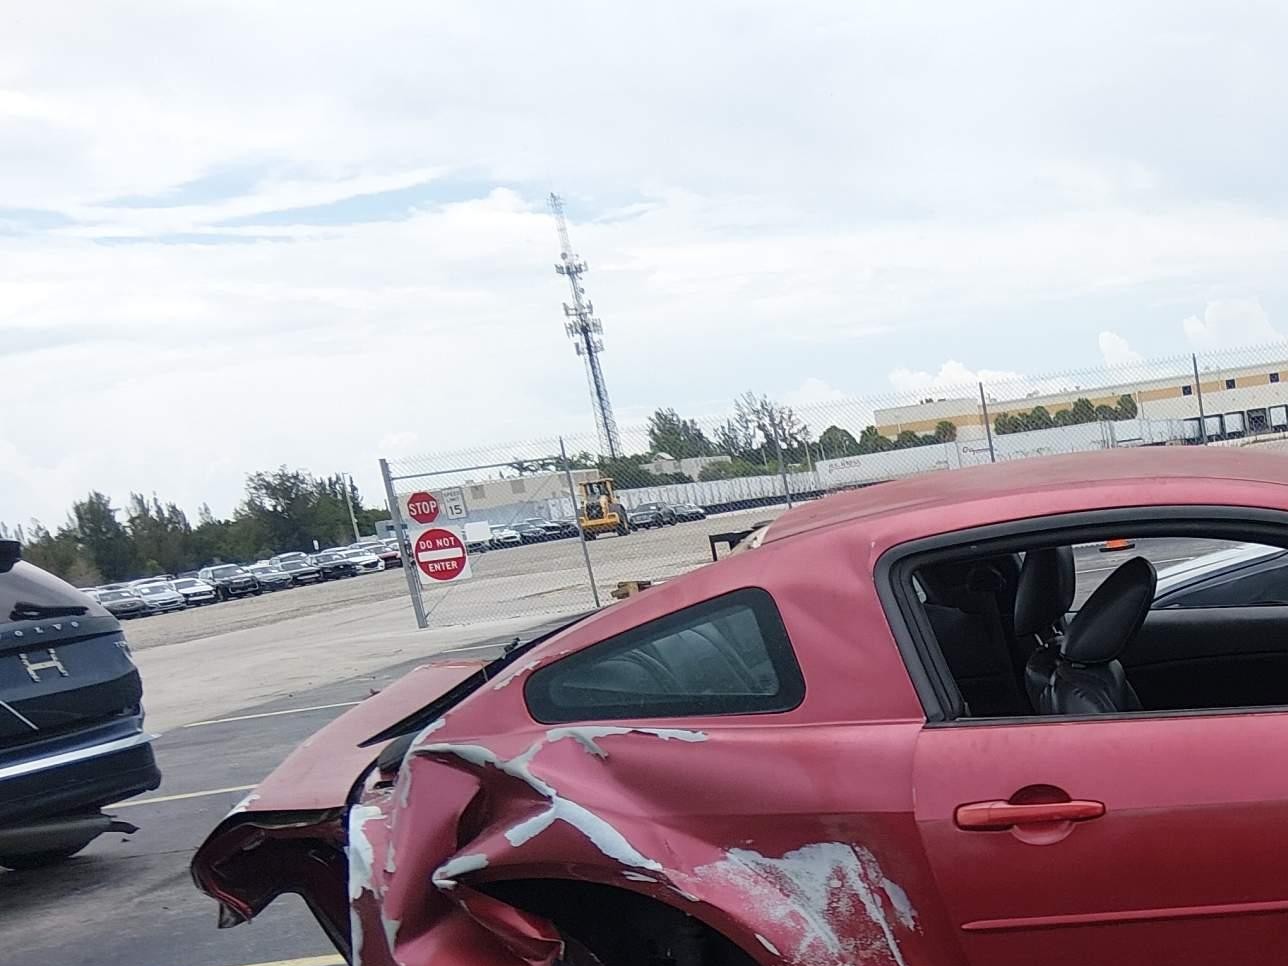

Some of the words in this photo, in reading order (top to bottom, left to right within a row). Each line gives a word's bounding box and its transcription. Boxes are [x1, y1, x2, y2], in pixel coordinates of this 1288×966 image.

[409, 501, 437, 516] STOP
[449, 505, 463, 516] 15
[420, 541, 433, 550] DO
[436, 538, 455, 548] NOT
[428, 561, 458, 573] ENTER
